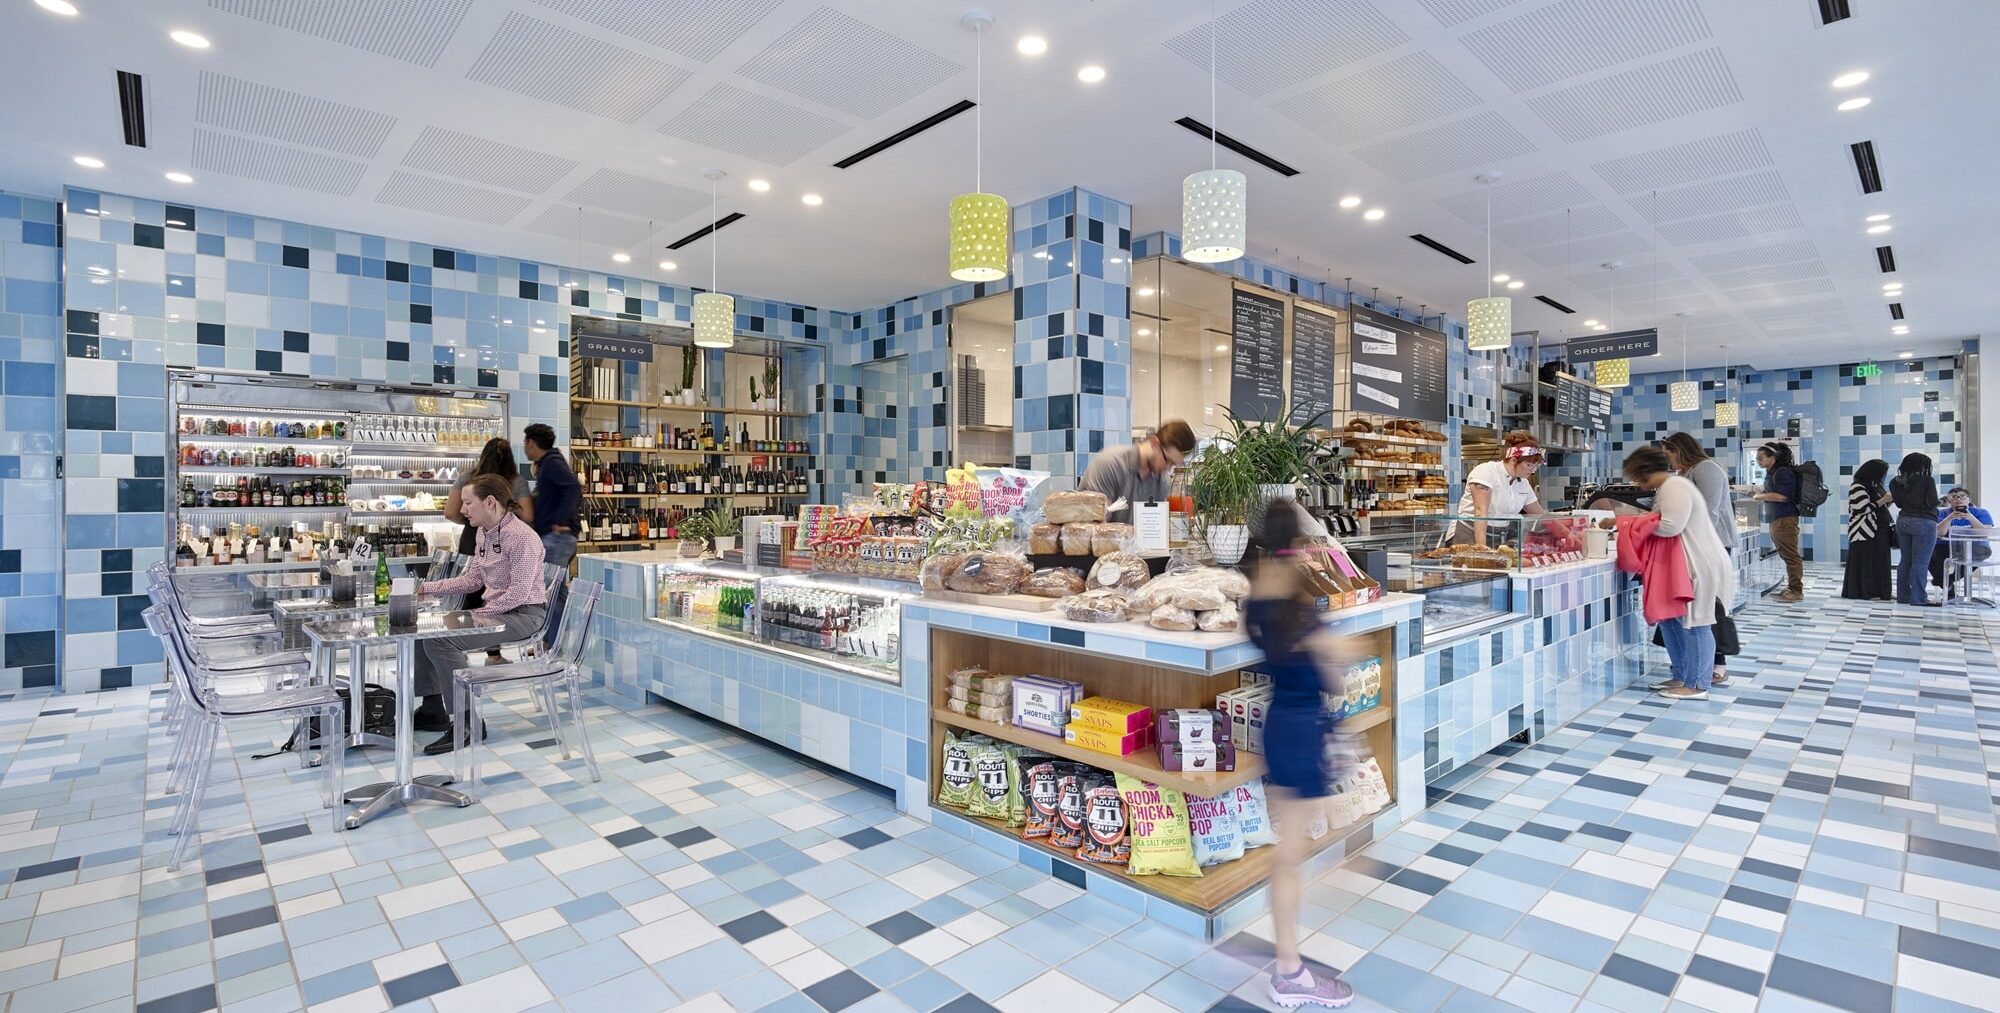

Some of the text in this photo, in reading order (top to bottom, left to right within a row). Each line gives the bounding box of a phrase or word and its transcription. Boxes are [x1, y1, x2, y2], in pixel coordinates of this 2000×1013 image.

[588, 343, 617, 352] GRAB
[630, 347, 644, 355] GO
[1574, 341, 1651, 356] ORDER HERE
[1857, 364, 1877, 378] EXIT
[355, 543, 369, 557] 42
[1023, 708, 1052, 721] SHORTIES
[1084, 715, 1113, 729] SNAPS
[1080, 735, 1107, 750] SNAPS
[950, 760, 971, 772] 11
[978, 762, 1007, 770] ROUTE
[945, 775, 972, 783] CHIPS
[981, 772, 1002, 784] 11
[1093, 798, 1120, 807] ROUTE
[1125, 790, 1161, 806] BOOM
[1096, 809, 1117, 822] 11
[1130, 805, 1175, 821] CHICKA
[1186, 801, 1228, 820] CHICKA
[1176, 814, 1184, 822] 35
[1244, 817, 1262, 827] BUTTER
[1091, 824, 1119, 832] CHIPS
[1133, 821, 1154, 837] POP
[1190, 818, 1213, 837] POP
[1147, 839, 1160, 847] SALT
[1161, 838, 1187, 847] POPCORN
[1203, 833, 1235, 846] REAL BUTTER
[1208, 841, 1232, 852] POPCORN
